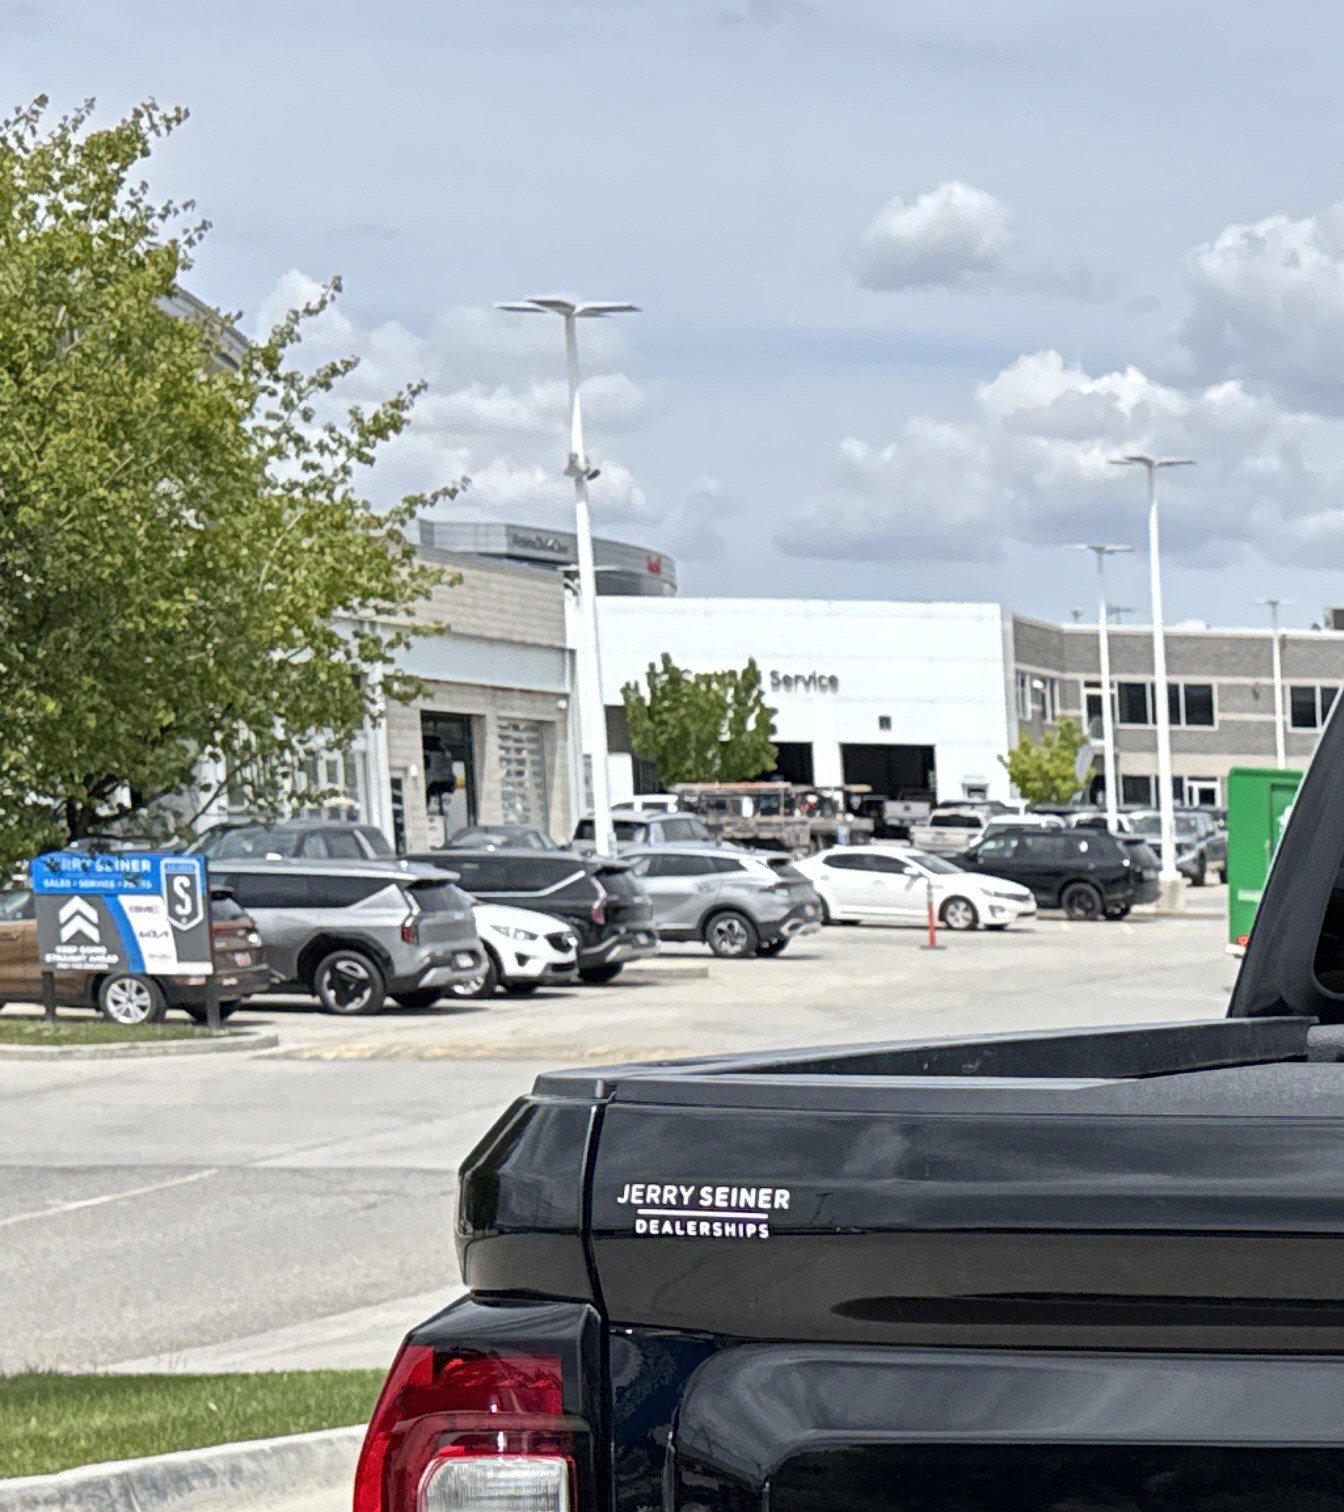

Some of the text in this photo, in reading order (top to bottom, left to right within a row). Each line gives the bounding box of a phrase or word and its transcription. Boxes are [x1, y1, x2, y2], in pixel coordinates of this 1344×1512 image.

[769, 670, 839, 692] Service
[617, 1184, 790, 1209] JERRY SEINER
[635, 1219, 769, 1239] DEALERSHIPS
